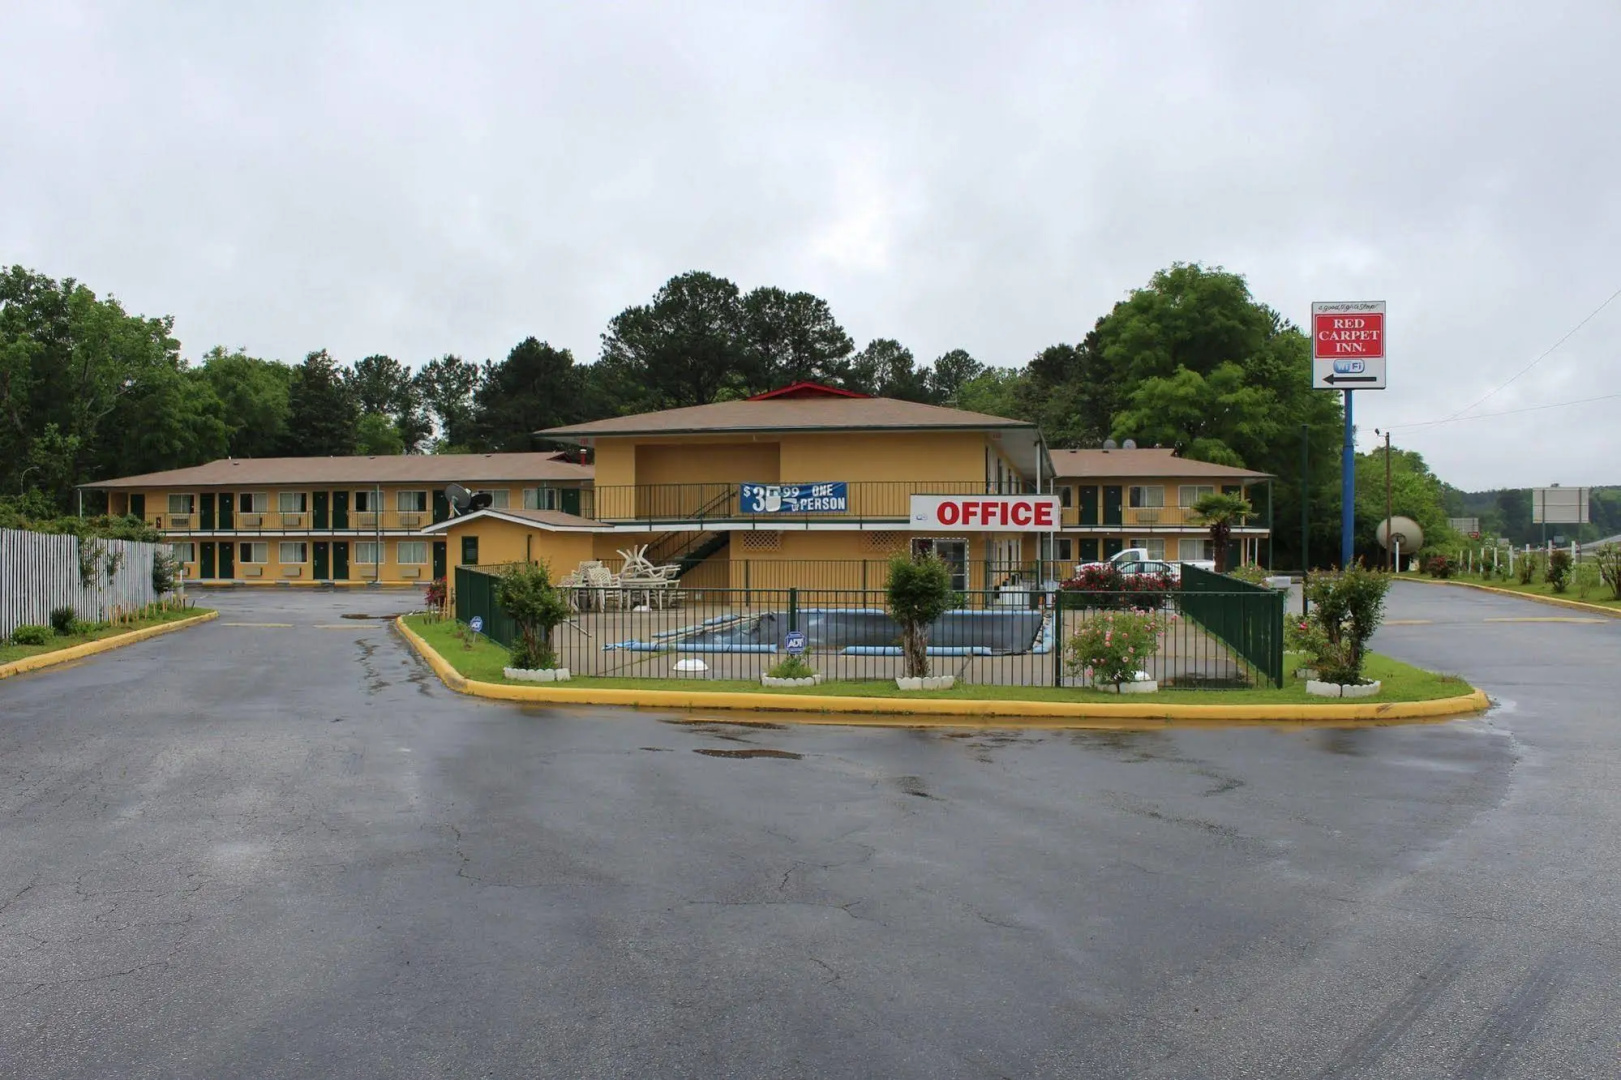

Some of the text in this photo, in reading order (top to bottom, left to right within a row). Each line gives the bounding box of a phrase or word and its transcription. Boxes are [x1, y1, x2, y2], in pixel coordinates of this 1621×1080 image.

[1333, 318, 1365, 329] RED
[1318, 330, 1380, 341] CARPET
[1335, 342, 1366, 353] INN.
[812, 484, 834, 497] ONE
[800, 497, 846, 511] PERSON
[937, 501, 1054, 526] OFFICE
[787, 638, 804, 648] ADT
